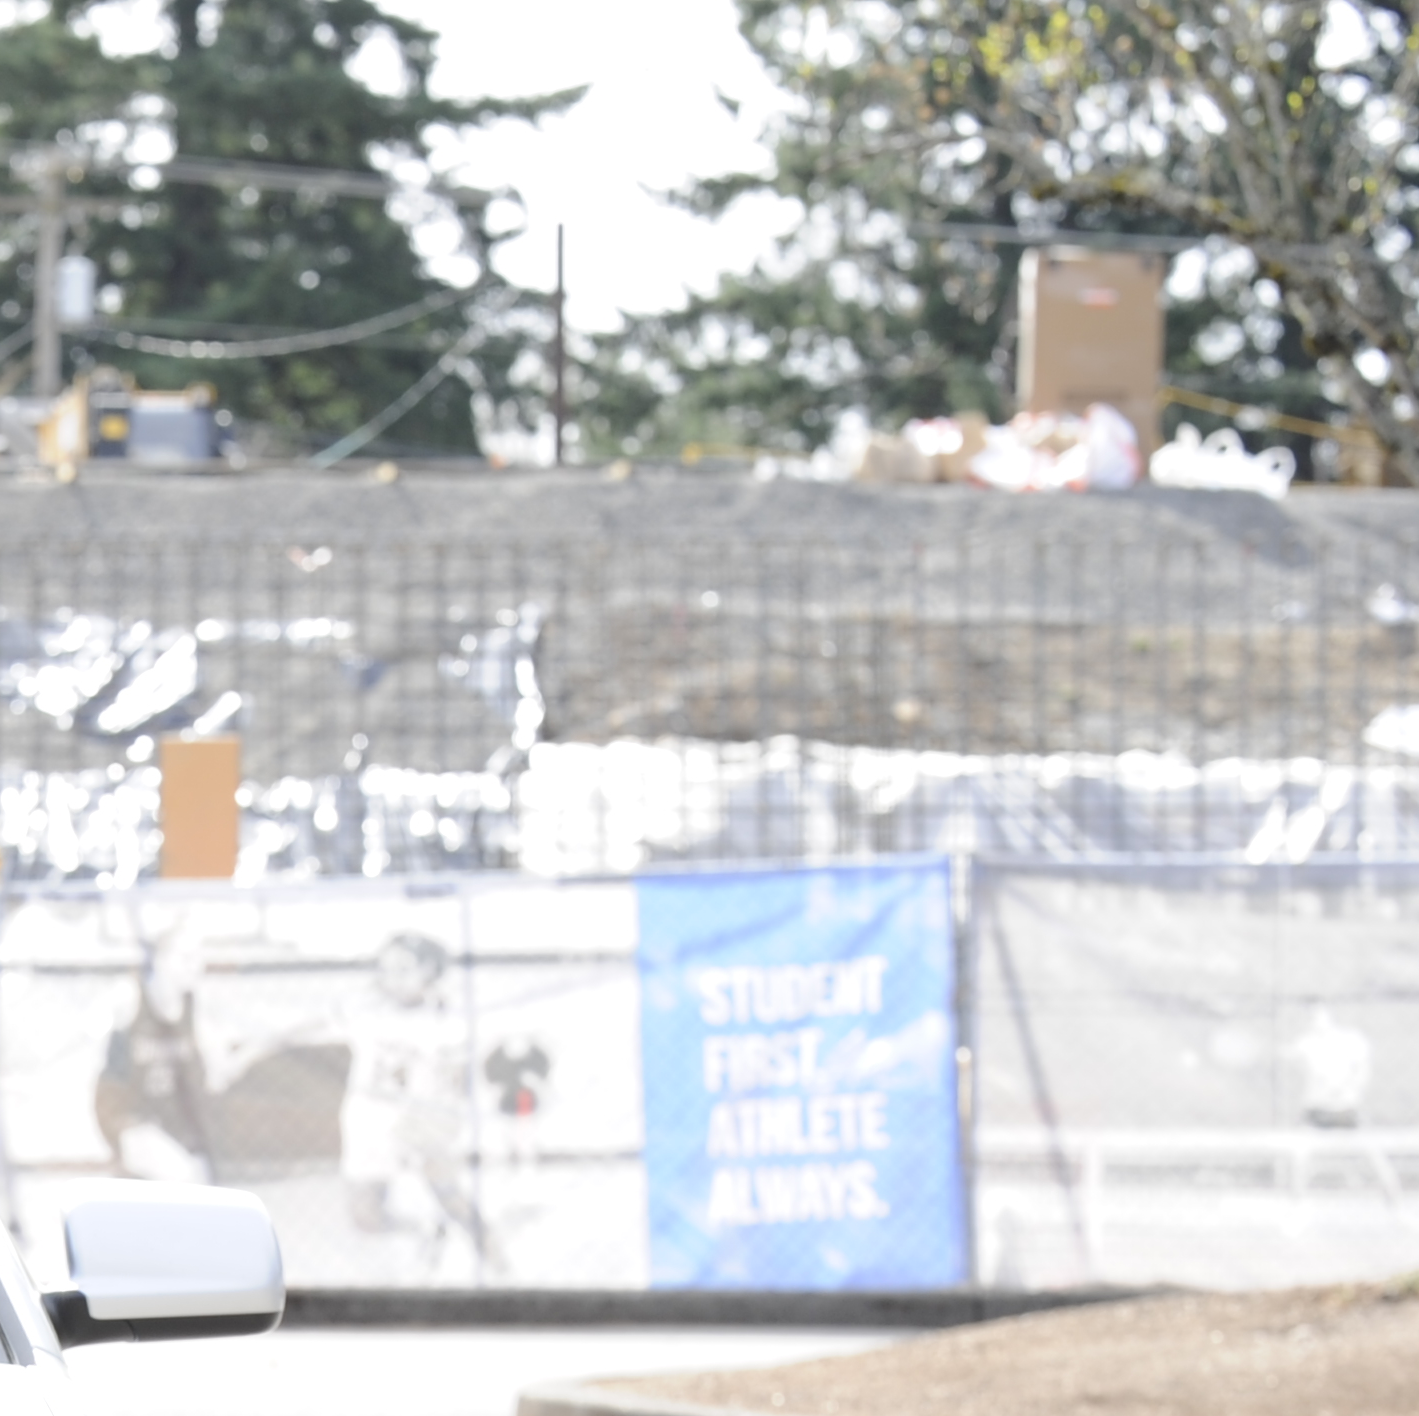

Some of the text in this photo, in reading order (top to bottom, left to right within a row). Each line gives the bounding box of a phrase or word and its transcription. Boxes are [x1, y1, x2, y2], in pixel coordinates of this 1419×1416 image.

[700, 956, 888, 1024] STUDENT
[708, 1092, 890, 1157] ATHLETE
[709, 1161, 889, 1224] ALWAYS.
